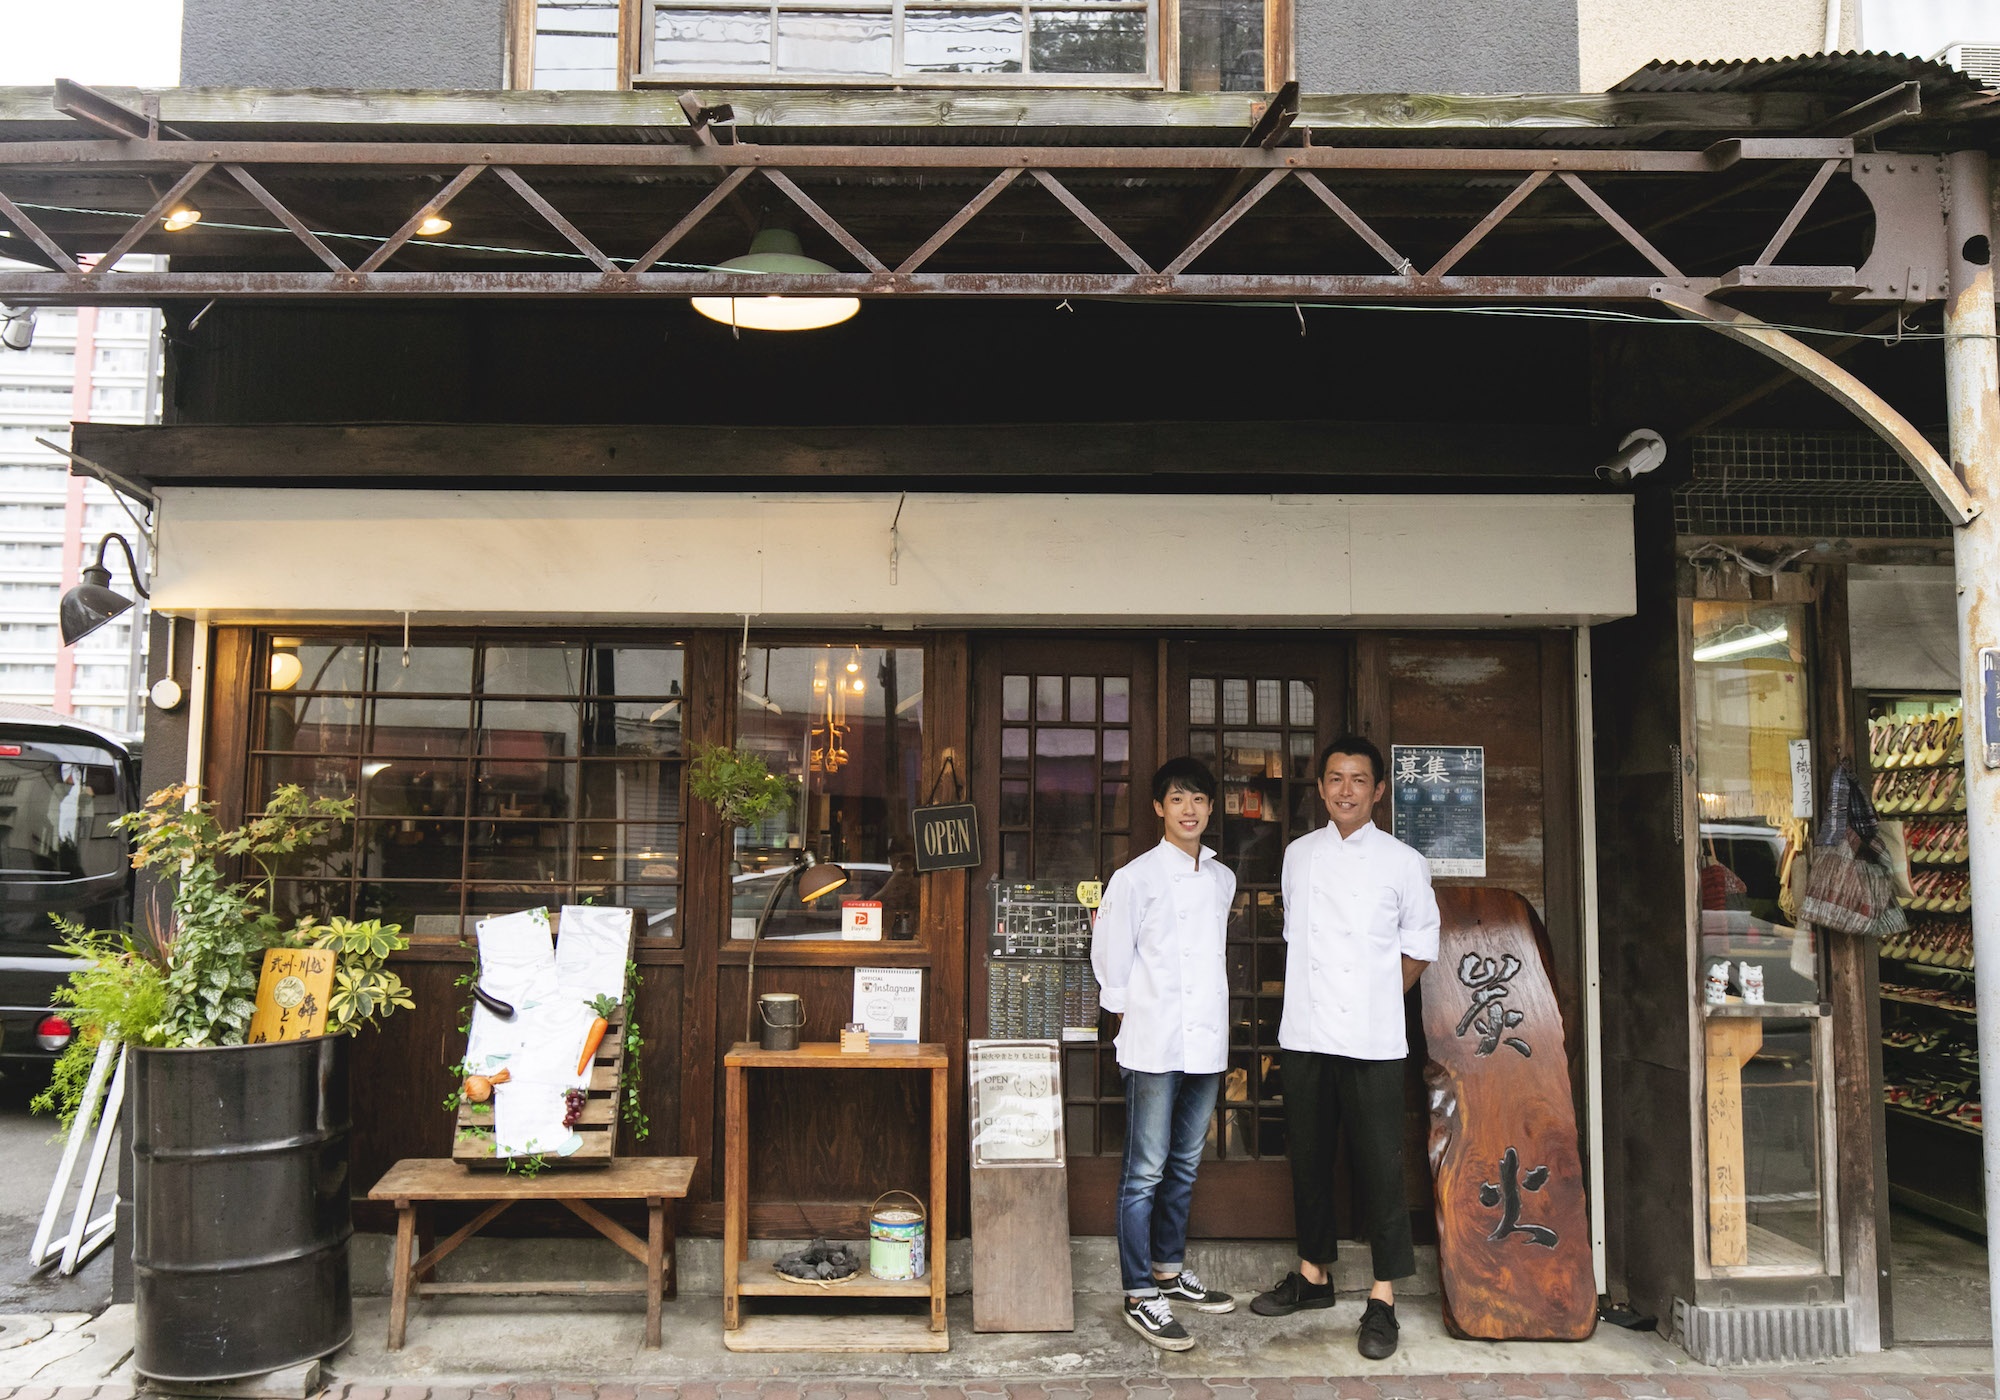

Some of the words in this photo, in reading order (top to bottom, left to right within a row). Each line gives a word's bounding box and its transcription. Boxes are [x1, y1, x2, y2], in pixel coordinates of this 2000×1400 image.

[1396, 755, 1450, 784] 募集
[924, 818, 970, 856] OPEN
[873, 983, 916, 996] Instagram
[984, 1075, 1009, 1084] OPEN
[1456, 952, 1559, 1250] 炭火
